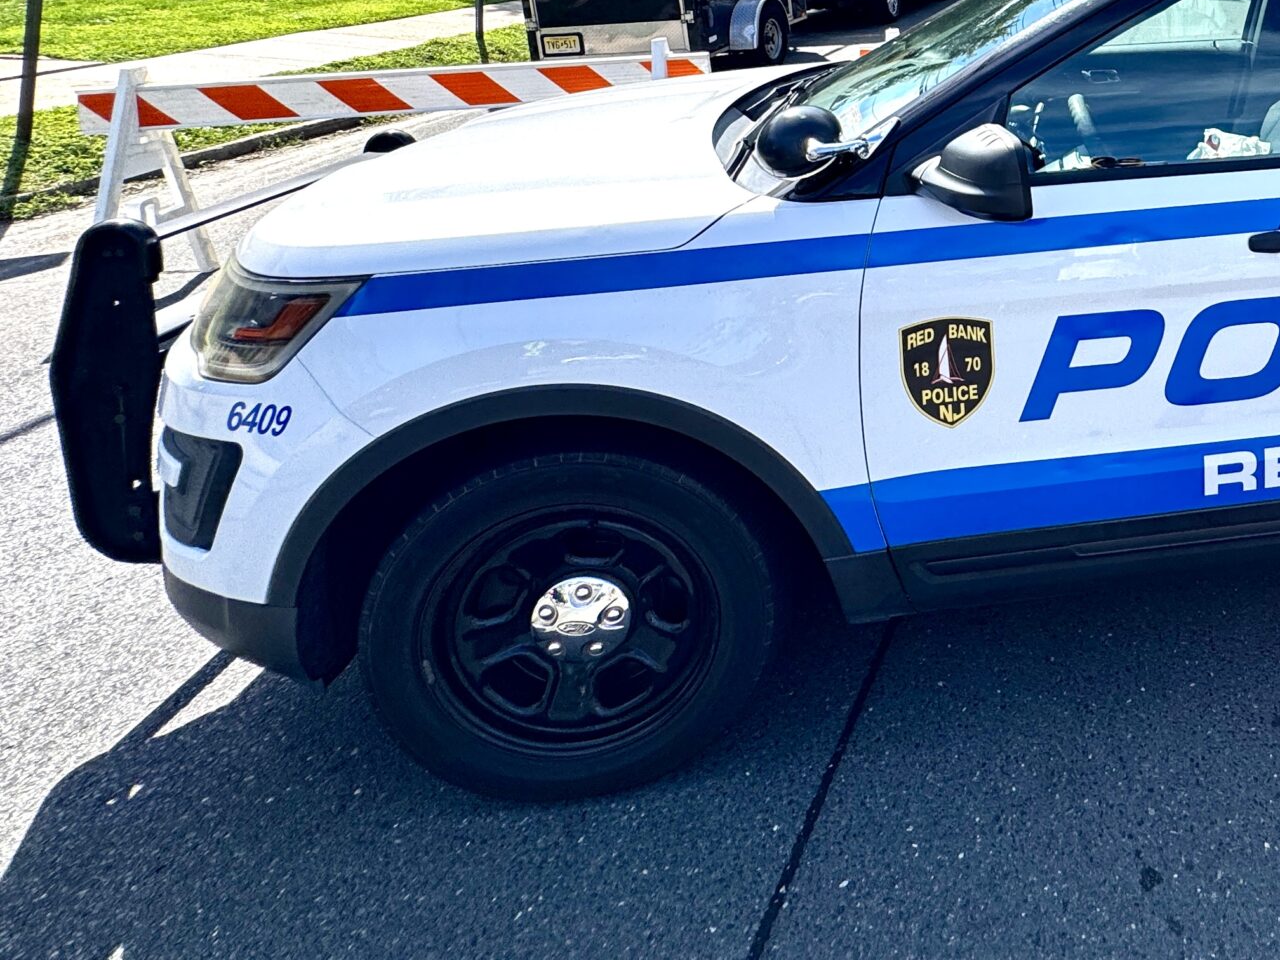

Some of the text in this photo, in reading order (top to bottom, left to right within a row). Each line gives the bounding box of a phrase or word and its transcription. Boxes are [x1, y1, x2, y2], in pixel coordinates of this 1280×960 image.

[907, 324, 987, 350] RED BANK
[913, 356, 981, 377] 18 70
[922, 384, 978, 405] POLICE
[226, 401, 293, 437] 6409
[939, 402, 966, 423] NJ
